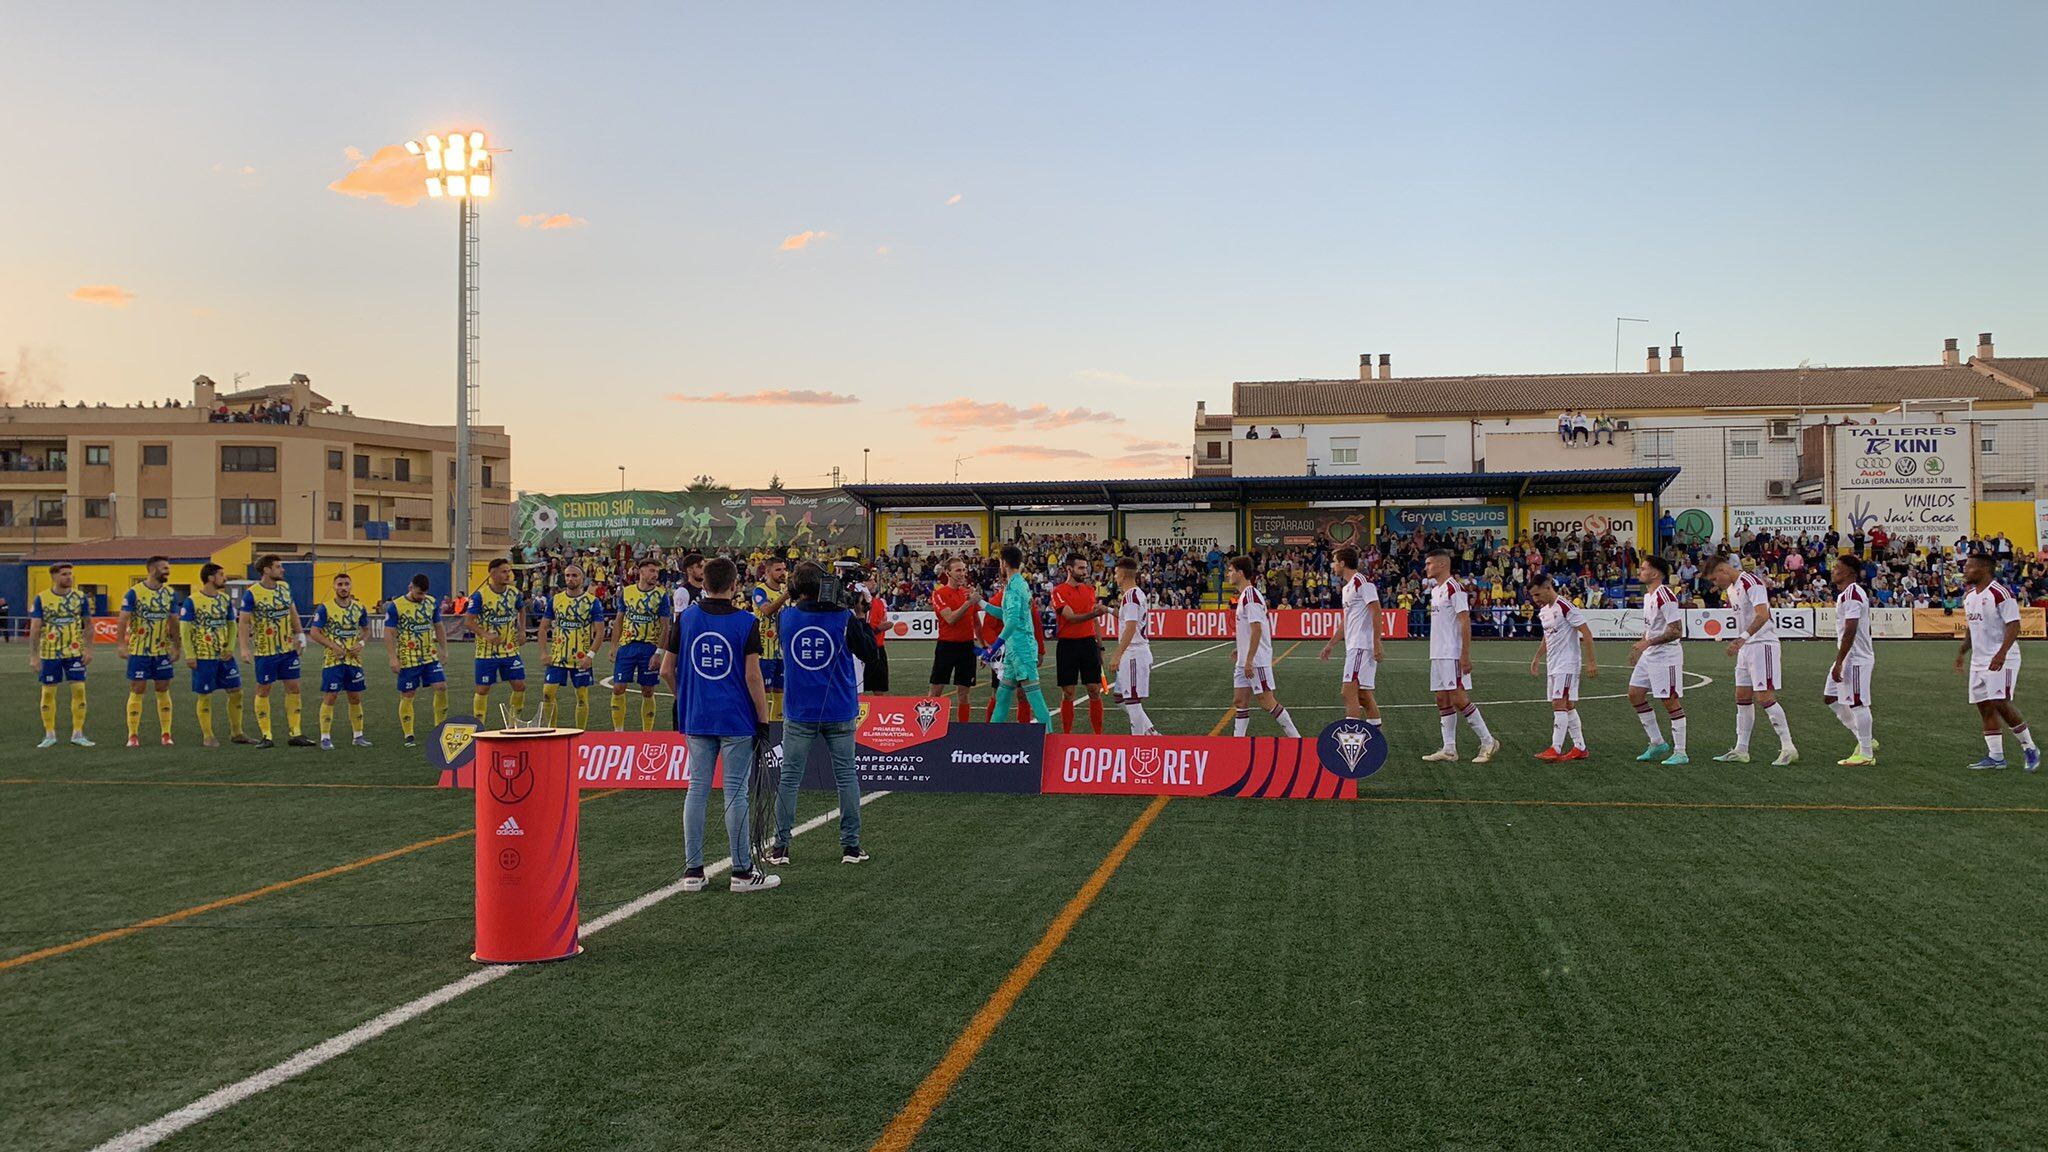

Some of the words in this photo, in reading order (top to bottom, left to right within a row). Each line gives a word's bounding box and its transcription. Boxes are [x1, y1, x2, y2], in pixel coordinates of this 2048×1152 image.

[1848, 427, 1957, 437] TALLERES
[1895, 439, 1937, 453] KINI
[1904, 494, 1955, 507] VINILOS
[562, 501, 608, 518] CENTRO
[611, 499, 634, 516] SUR
[1400, 510, 1447, 525] feryval
[1451, 509, 1505, 525] Seguros
[1884, 508, 1914, 522] Javi
[1920, 508, 1955, 522] Coca
[576, 520, 602, 528] NUESTRA
[631, 518, 640, 527] EN
[643, 517, 650, 526] EL
[651, 517, 674, 526] CAMPO
[1024, 519, 1097, 527] distribuciones
[1253, 520, 1263, 531] EL
[562, 530, 575, 539] NOS
[576, 529, 595, 538] LLEVE
[596, 529, 601, 537] A
[601, 529, 610, 537] LA
[610, 528, 635, 537] VICTORIA
[1165, 537, 1218, 546] AYUNTAMIENTO
[1186, 612, 1227, 636] COPA
[878, 713, 905, 725] VS
[579, 744, 635, 781] COPA
[855, 755, 924, 763] AMPEONATO
[951, 751, 1030, 764] finetwork
[871, 763, 915, 771] ESPAÑA
[1063, 747, 1127, 783] COPA
[1162, 749, 1209, 785] REY
